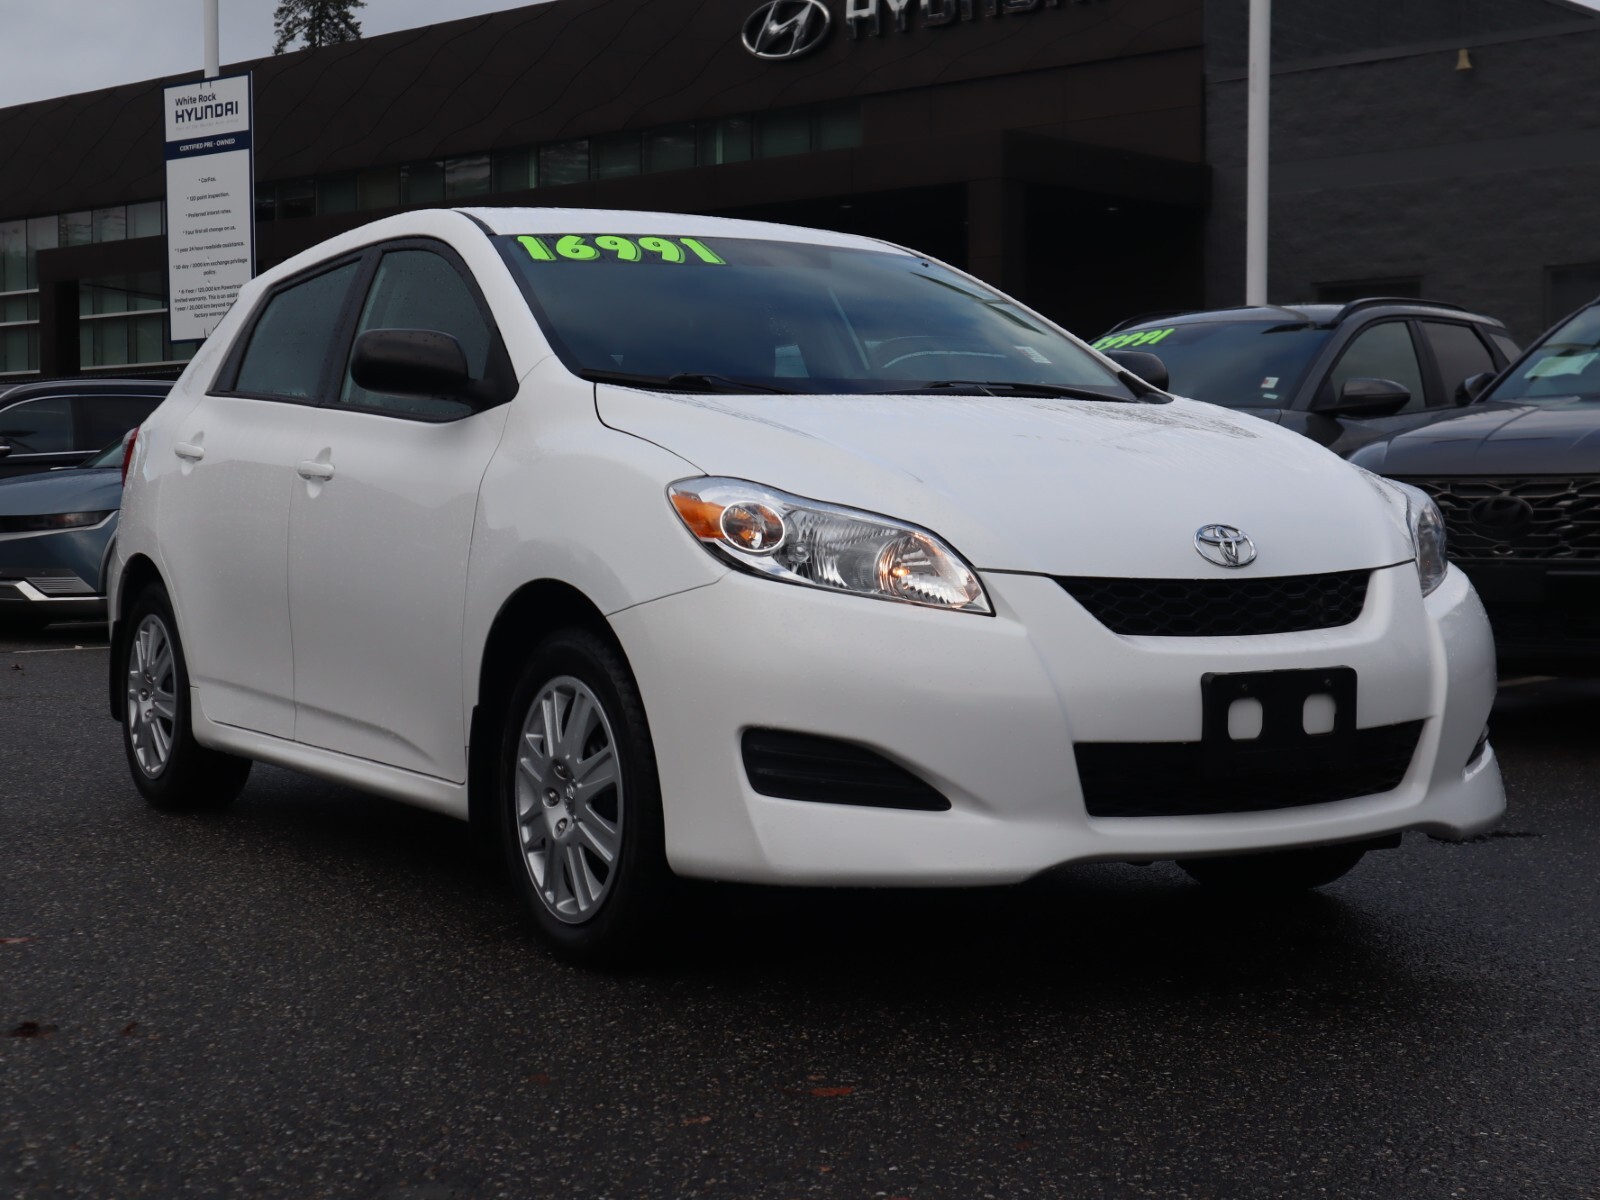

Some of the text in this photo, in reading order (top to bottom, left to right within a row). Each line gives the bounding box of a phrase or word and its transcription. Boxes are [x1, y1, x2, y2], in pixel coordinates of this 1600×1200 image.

[175, 92, 217, 106] White Rock
[175, 101, 239, 124] HYUNDAI
[180, 143, 204, 151] CERTIFIED
[204, 141, 213, 149] PRE
[216, 138, 236, 147] OWNED
[517, 235, 727, 265] 16991
